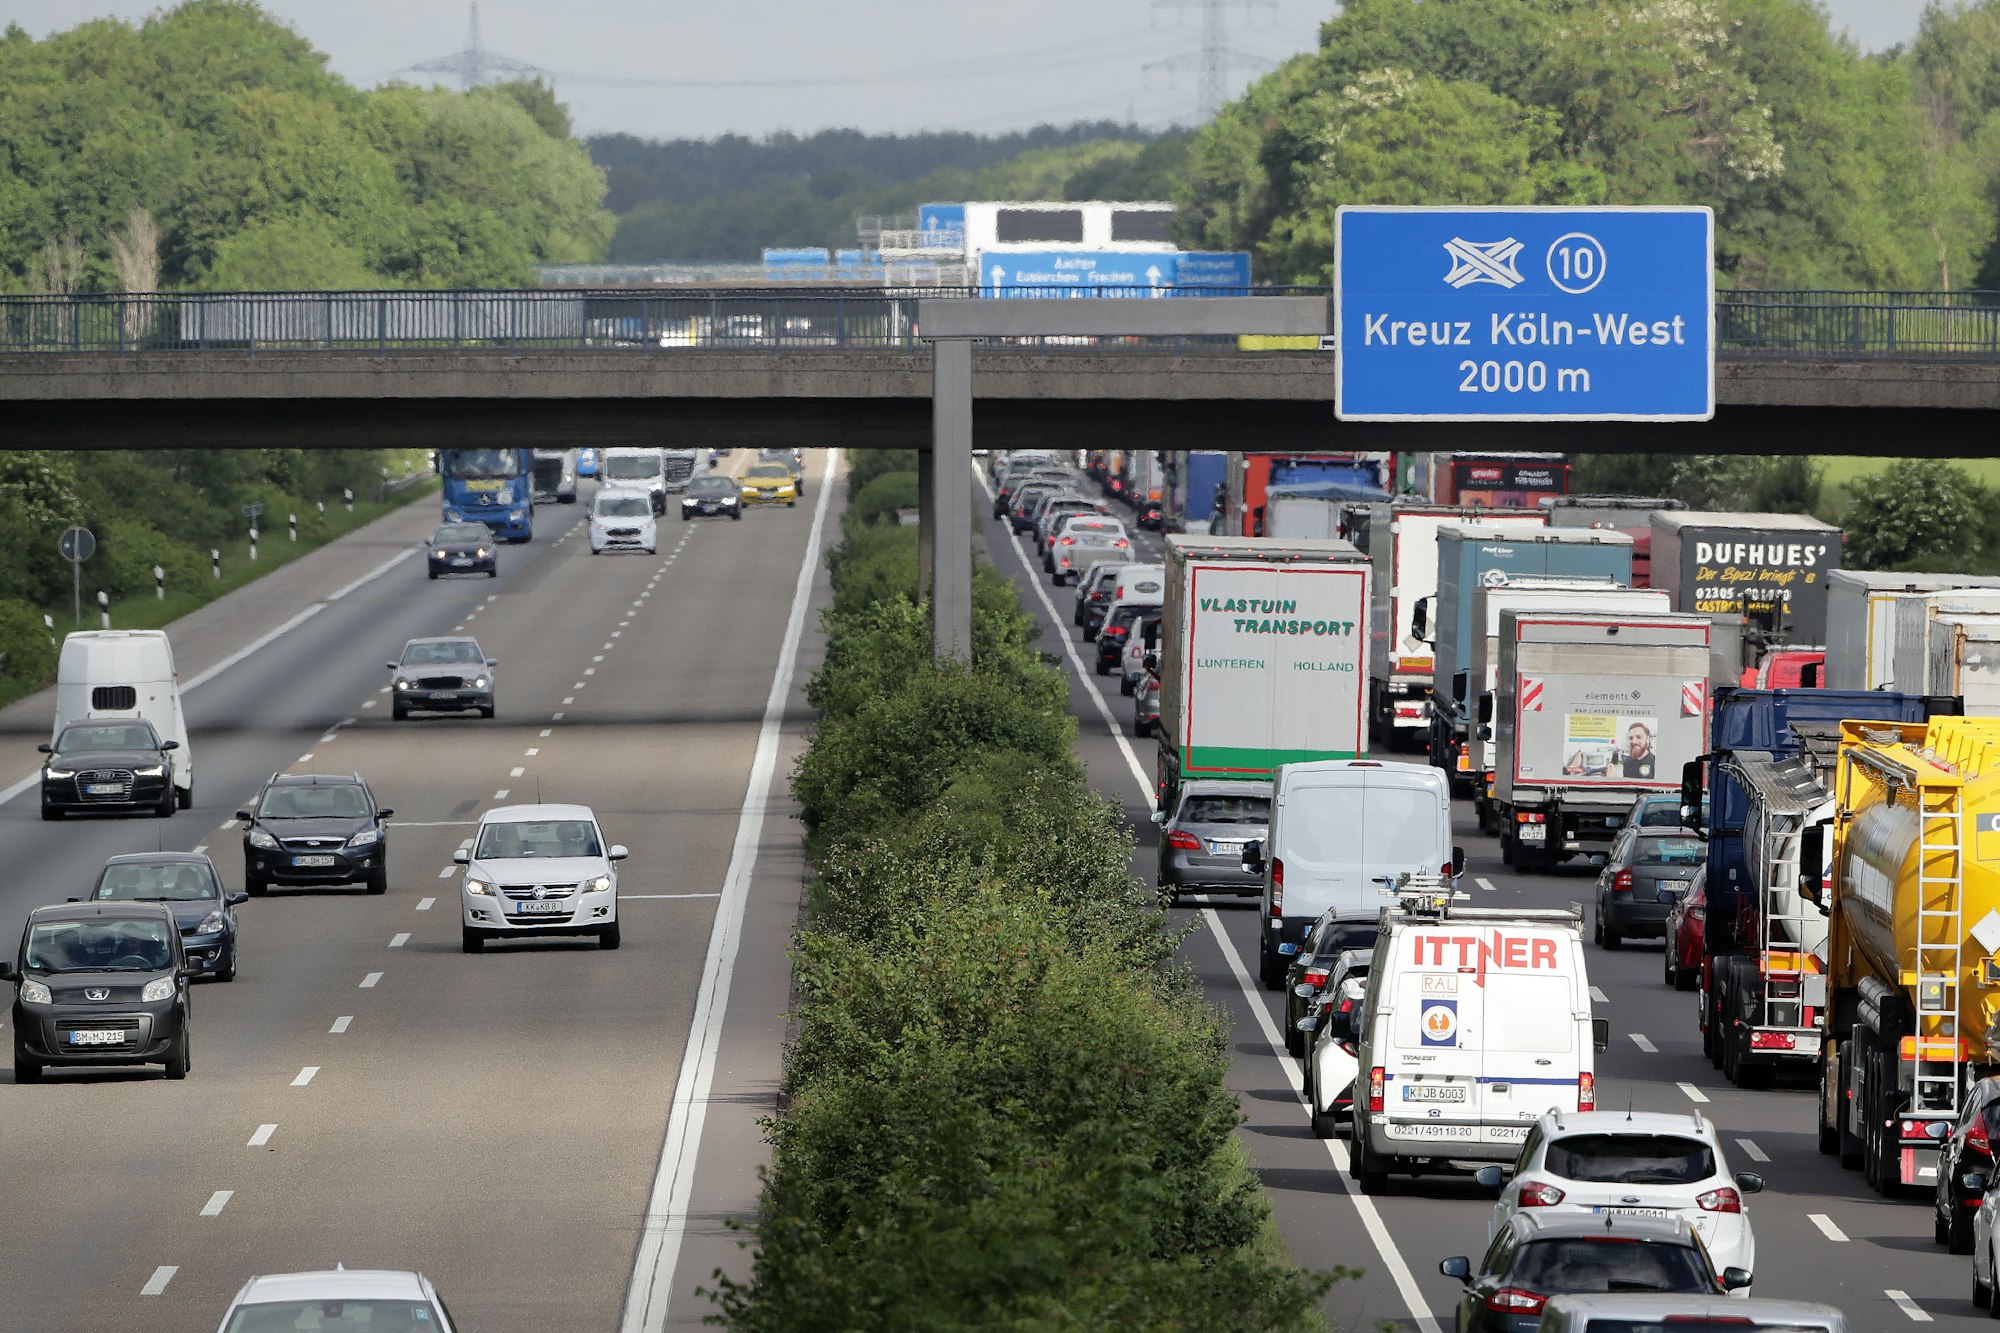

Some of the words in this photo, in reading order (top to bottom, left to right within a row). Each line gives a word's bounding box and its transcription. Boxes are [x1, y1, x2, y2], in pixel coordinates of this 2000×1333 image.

[1558, 247, 1595, 280] 10
[1365, 313, 1471, 346] Kreuz
[1491, 312, 1685, 346] Köln-West
[1458, 360, 1547, 392] 2000
[1557, 367, 1591, 392] m
[1696, 566, 1718, 581] Der
[1720, 566, 1757, 584] Spezi
[1695, 586, 1735, 600] 02305
[1200, 598, 1297, 614] VLASTUIN
[1233, 619, 1355, 637] TRANSPORT
[1197, 658, 1265, 669] LUNTEREN
[1293, 661, 1354, 672] HOLLAND
[1585, 691, 1628, 701] elements
[1414, 930, 1557, 972] ITTNER
[1424, 976, 1455, 991] RAL
[75, 1032, 88, 1042] BM
[93, 1032, 105, 1041] MJ
[106, 1031, 123, 1041] 215
[1410, 1088, 1417, 1098] K
[1423, 1088, 1437, 1098] JB
[1439, 1088, 1464, 1099] 6003
[1518, 1111, 1537, 1120] Fax
